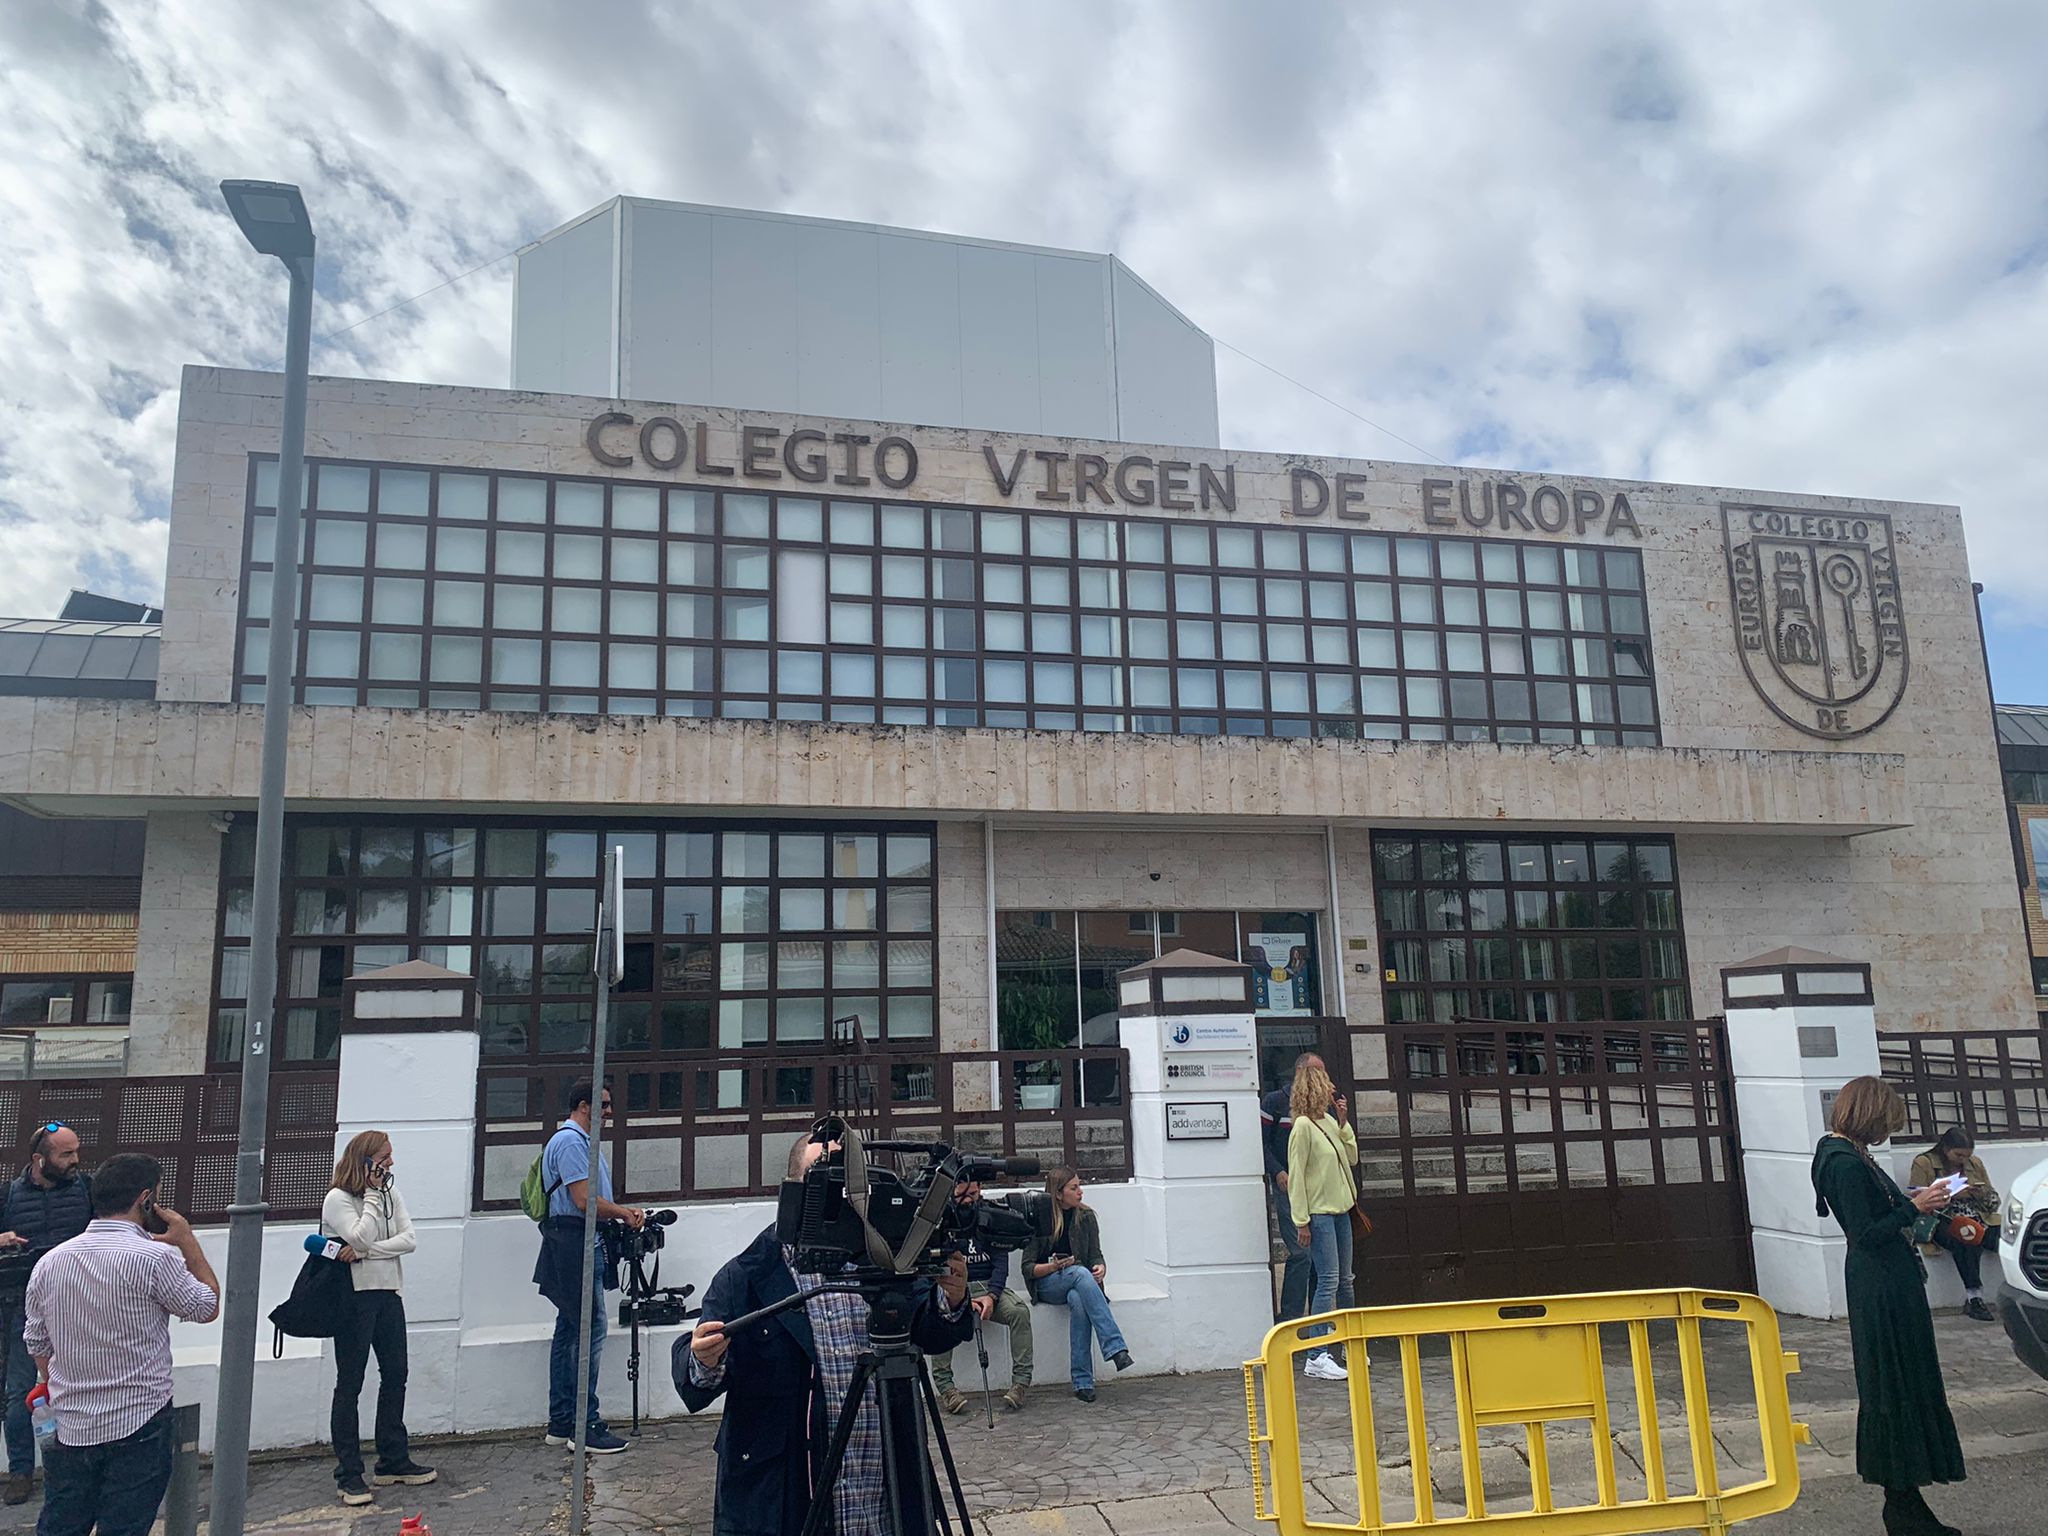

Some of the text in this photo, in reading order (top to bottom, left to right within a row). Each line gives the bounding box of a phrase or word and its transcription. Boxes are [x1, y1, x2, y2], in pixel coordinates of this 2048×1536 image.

[587, 412, 1643, 538] COLEGIO VIRGEN DE EUROPA
[1748, 510, 1869, 541] COLEGIO
[1732, 541, 1763, 651] EUROPA
[1871, 545, 1903, 658] VIRGEN
[1816, 708, 1852, 730] DE
[1172, 1119, 1223, 1129] addvantage
